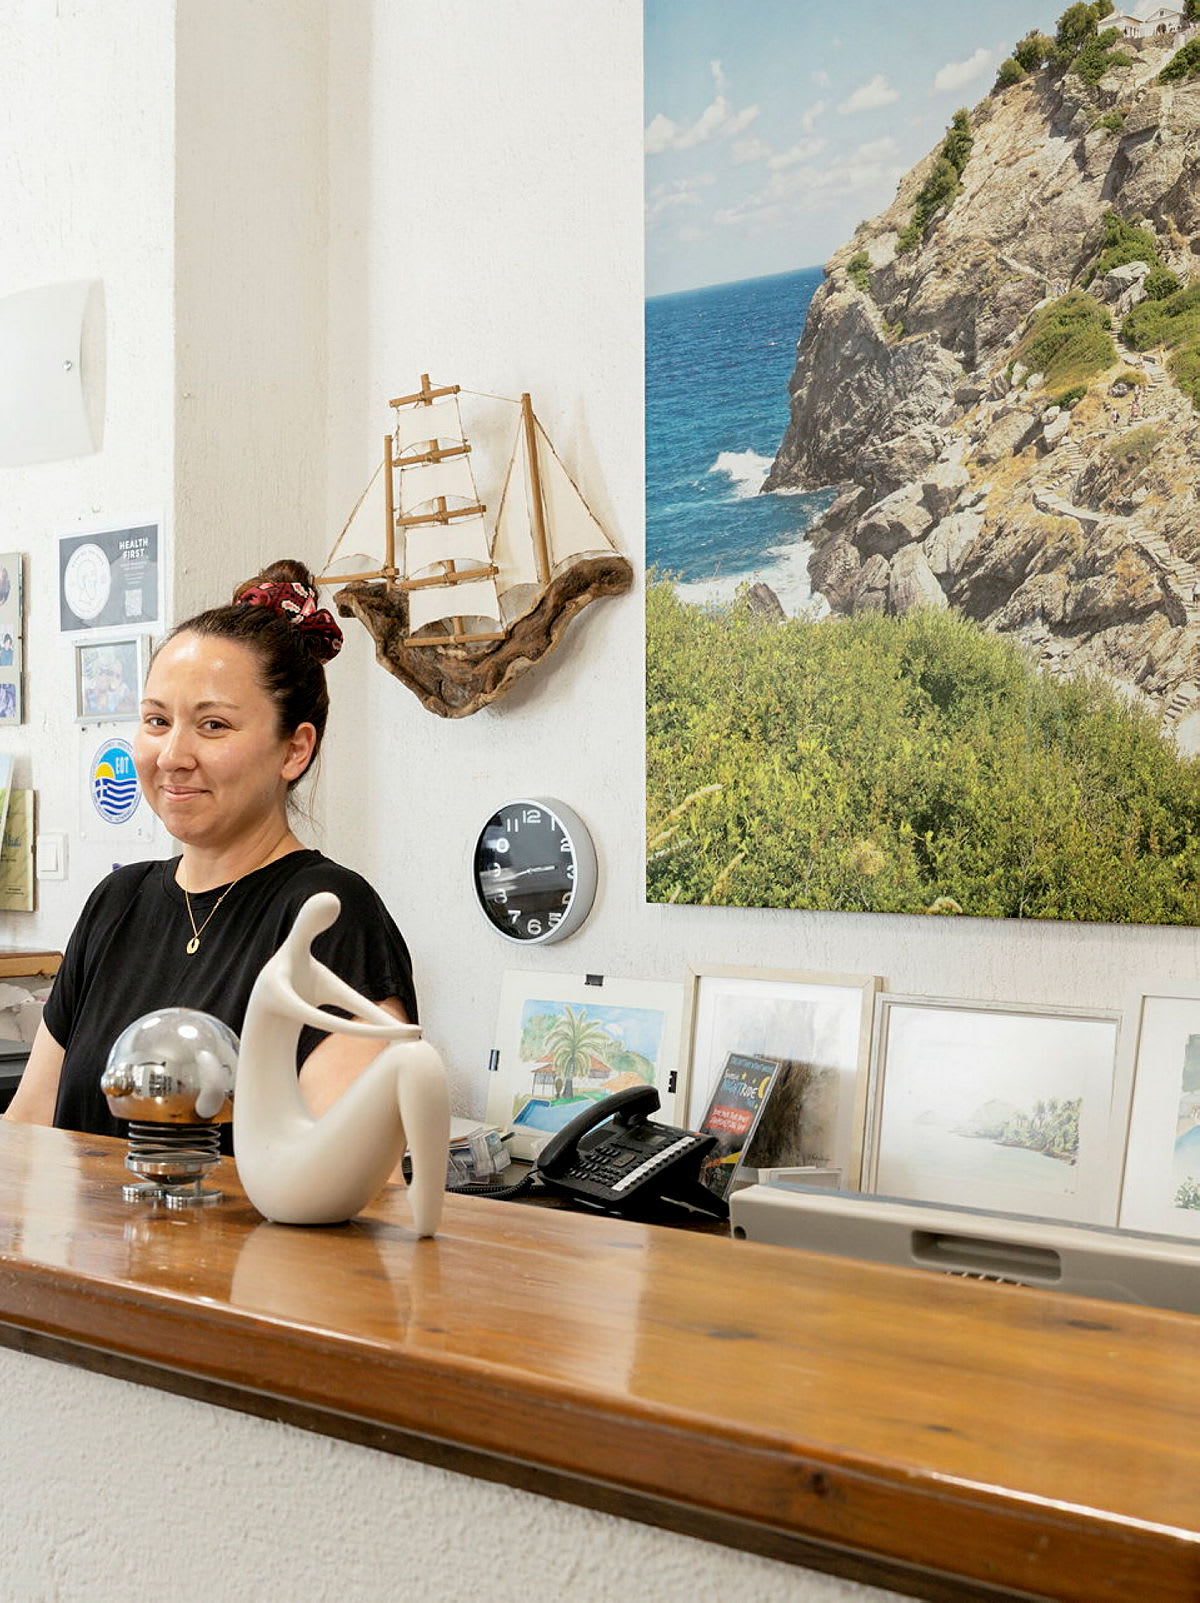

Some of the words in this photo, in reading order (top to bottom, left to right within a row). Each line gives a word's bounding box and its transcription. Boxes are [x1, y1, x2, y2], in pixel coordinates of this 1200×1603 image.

[119, 537, 149, 550] HEALTH
[122, 548, 145, 560] FIRST
[522, 809, 541, 824] 12
[506, 818, 519, 832] 11
[560, 837, 571, 852] 2
[507, 909, 521, 924] 7
[548, 912, 562, 927] 5
[527, 918, 542, 935] 6
